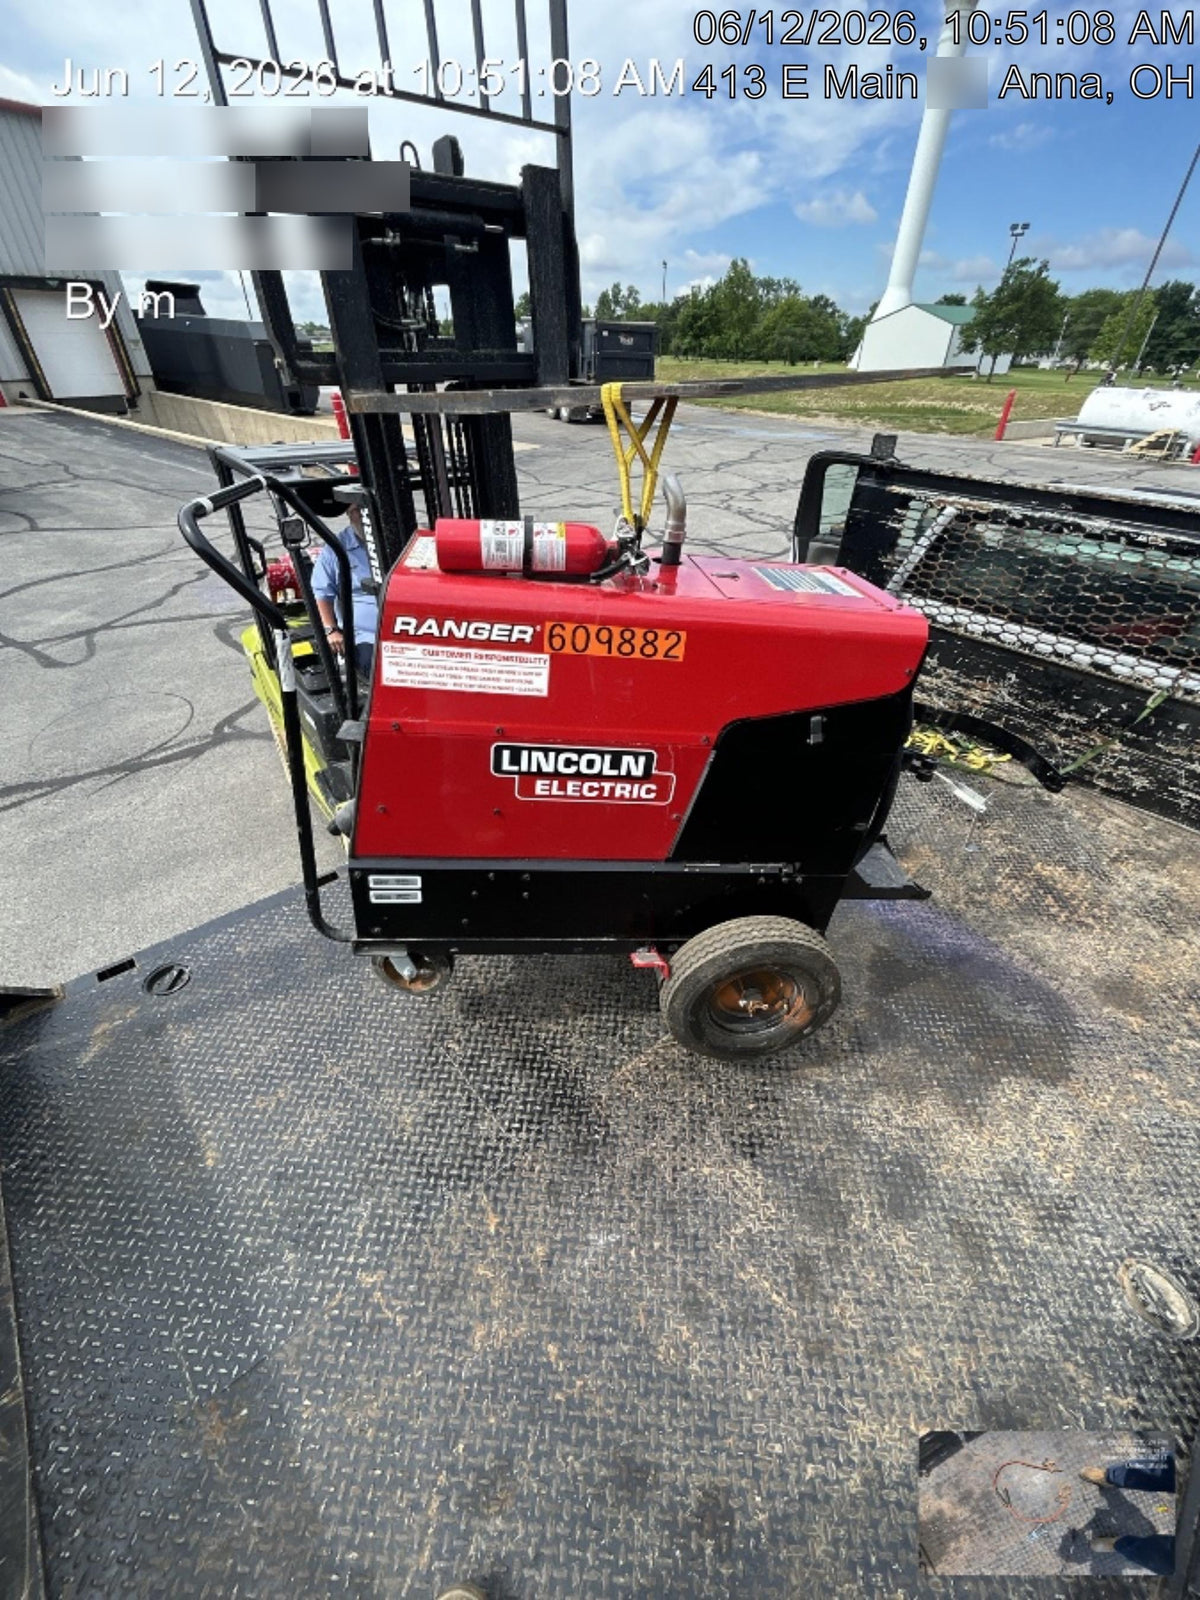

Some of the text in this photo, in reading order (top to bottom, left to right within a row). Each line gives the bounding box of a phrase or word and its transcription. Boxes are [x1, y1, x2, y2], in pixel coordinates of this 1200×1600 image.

[548, 623, 682, 659] 609882
[502, 749, 647, 777] LINCOLN
[535, 779, 658, 799] ELECTRIC
